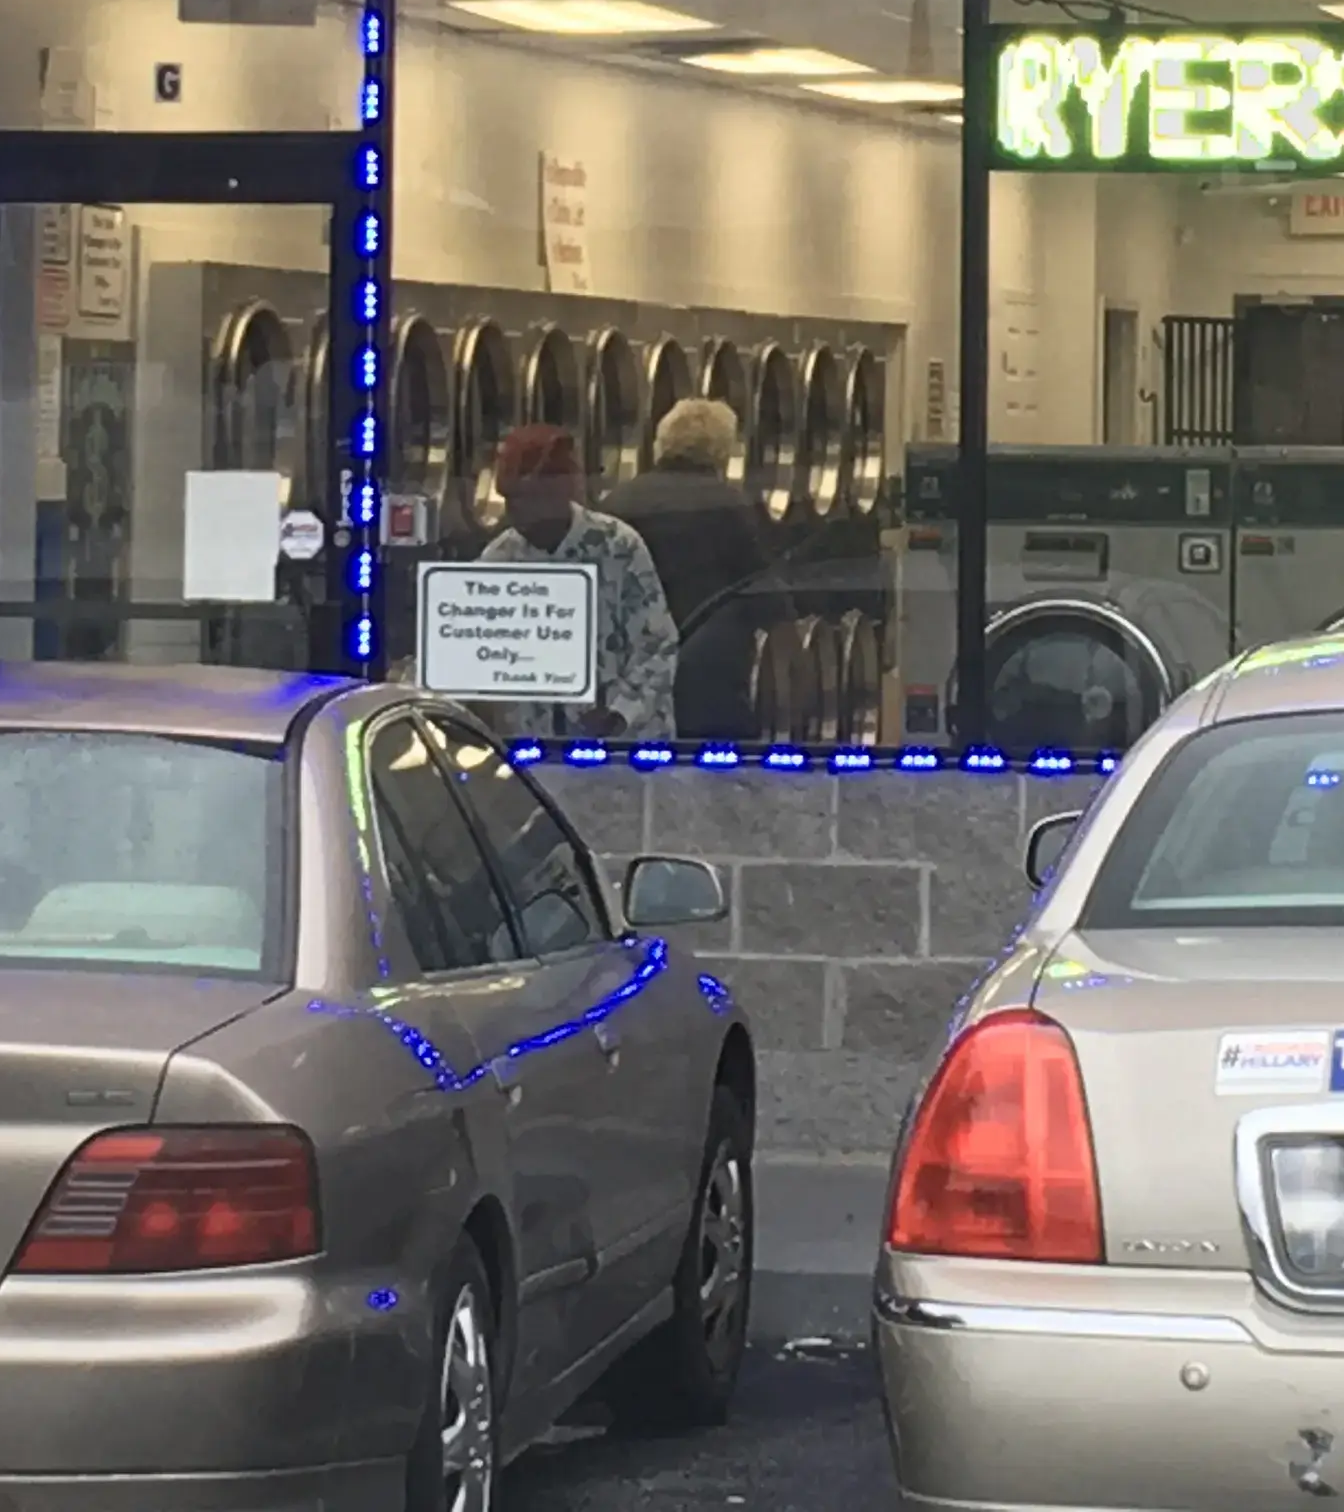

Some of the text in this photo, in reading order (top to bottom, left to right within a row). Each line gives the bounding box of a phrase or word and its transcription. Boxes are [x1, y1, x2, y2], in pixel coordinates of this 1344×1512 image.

[156, 64, 181, 100] G
[465, 581, 550, 597] The Coin
[438, 602, 576, 620] Changer Is For
[439, 624, 573, 640] Customer Use
